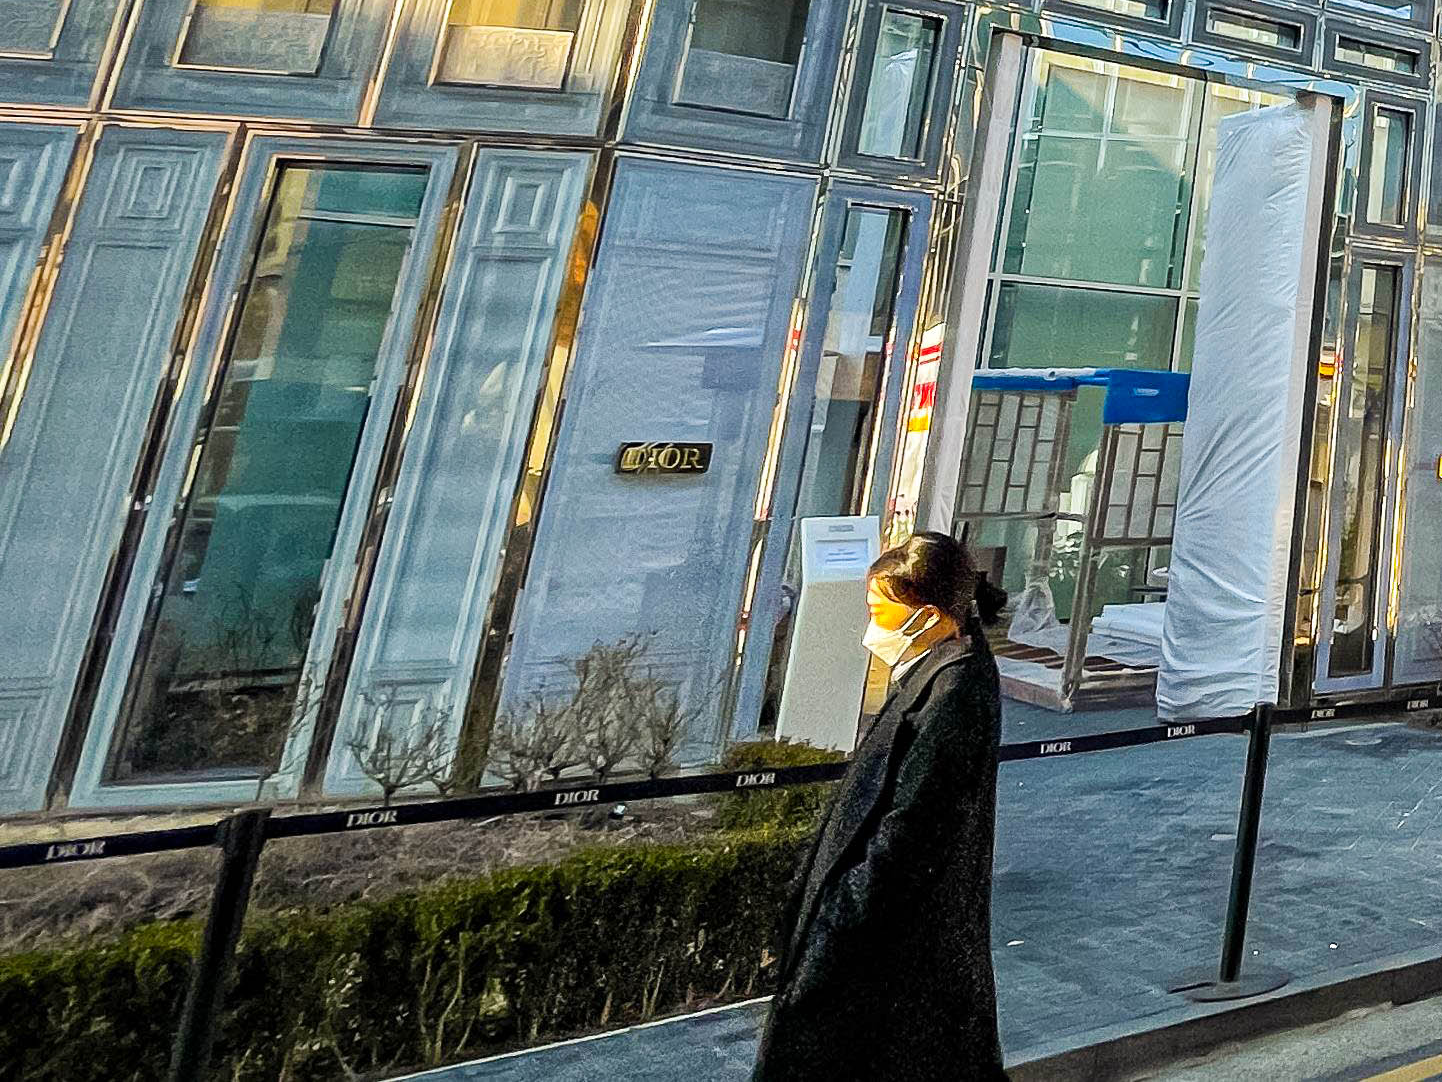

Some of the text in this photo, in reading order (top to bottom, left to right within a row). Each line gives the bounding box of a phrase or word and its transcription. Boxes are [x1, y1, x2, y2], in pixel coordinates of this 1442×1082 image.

[620, 447, 704, 470] DIOR
[1167, 724, 1196, 738] DIOR
[1040, 741, 1072, 754] DIOR
[736, 772, 776, 787] DIOR
[554, 789, 600, 806] DIOR
[346, 809, 398, 829] DIOR
[46, 840, 106, 861] DIOR
